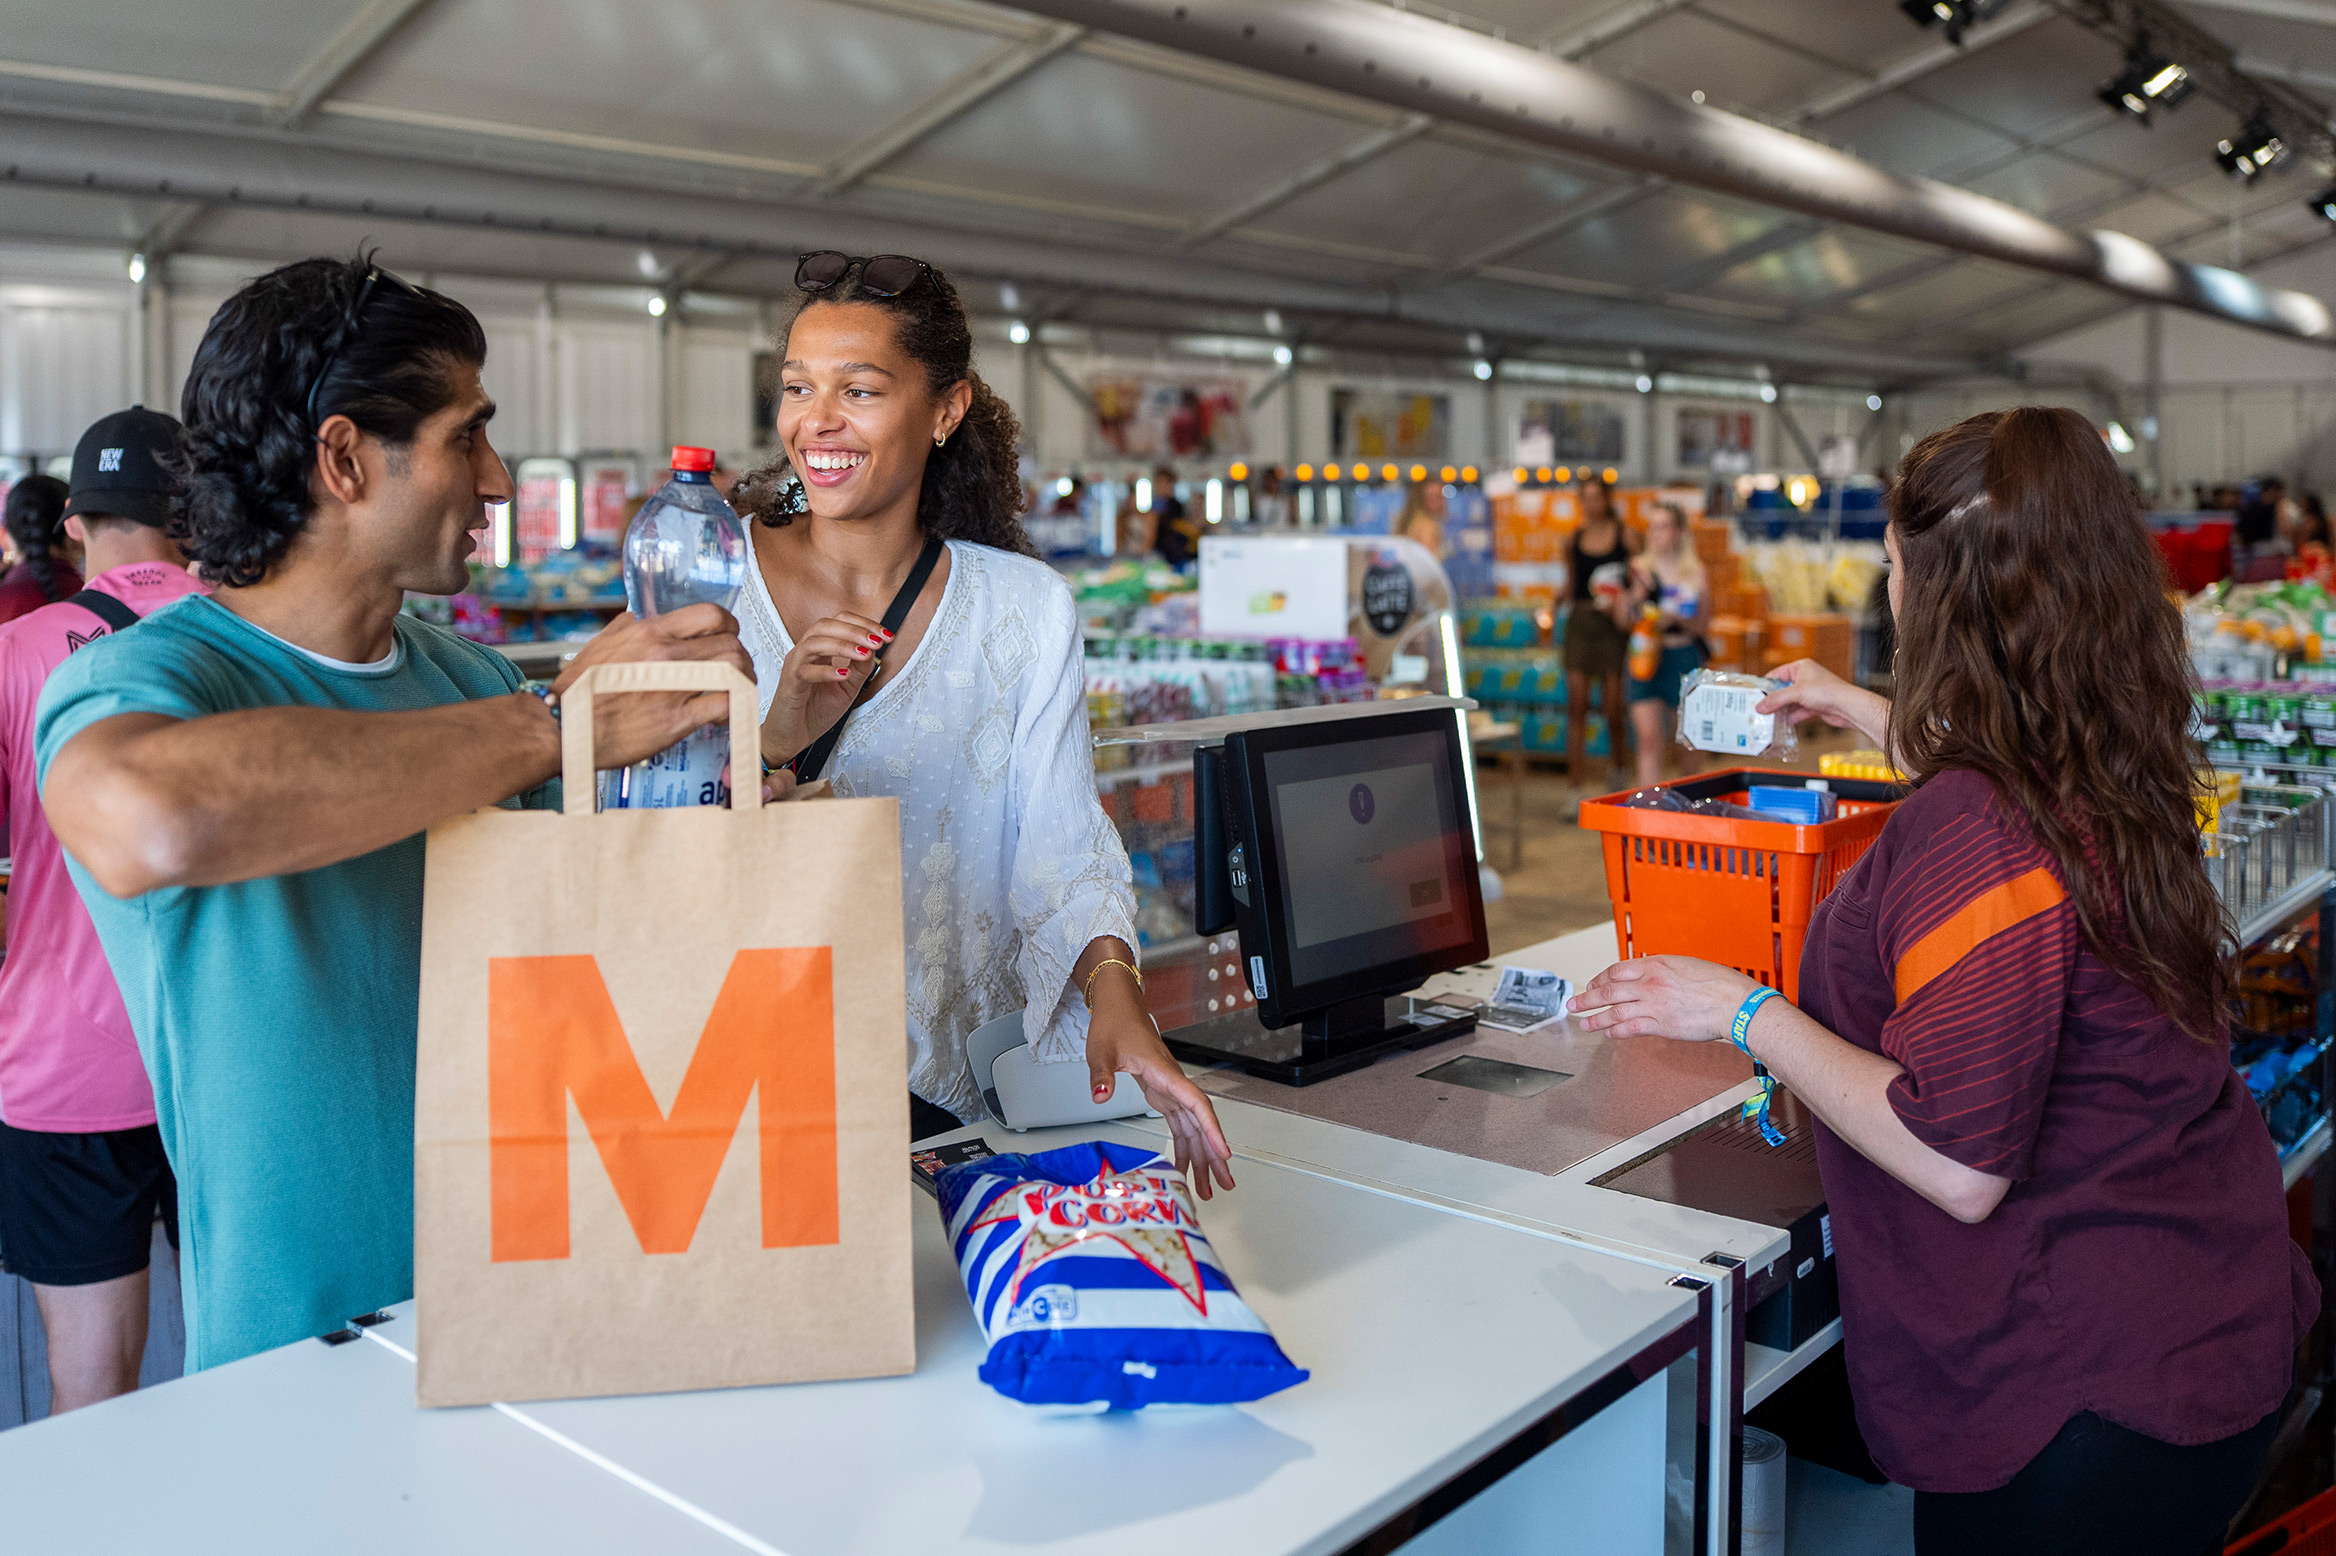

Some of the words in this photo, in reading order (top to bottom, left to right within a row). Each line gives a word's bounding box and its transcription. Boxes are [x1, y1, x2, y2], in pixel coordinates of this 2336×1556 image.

[98, 459, 121, 472] ERA
[100, 448, 124, 460] NEW
[1733, 1010, 1751, 1044] STAFF
[488, 945, 839, 1264] M
[1048, 1197, 1200, 1229] CORN
